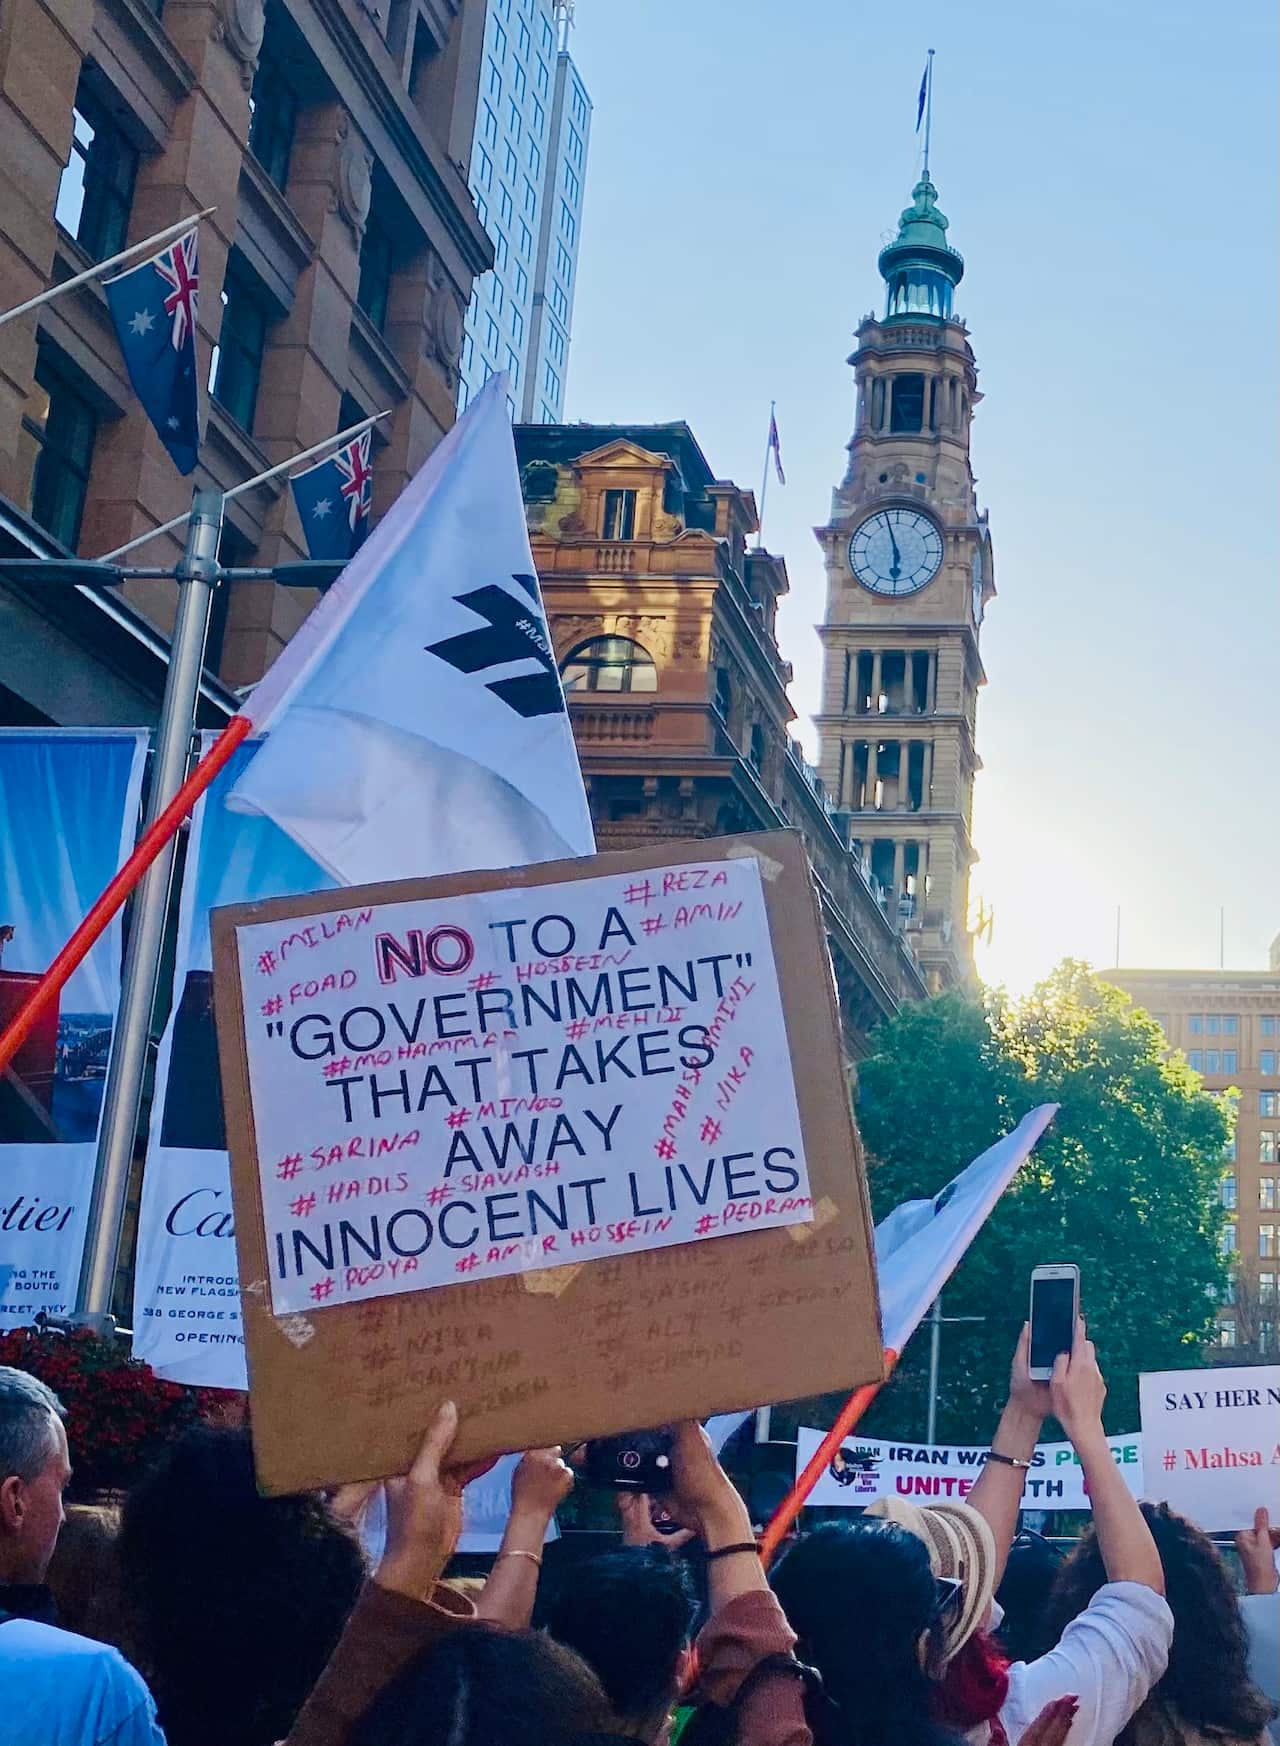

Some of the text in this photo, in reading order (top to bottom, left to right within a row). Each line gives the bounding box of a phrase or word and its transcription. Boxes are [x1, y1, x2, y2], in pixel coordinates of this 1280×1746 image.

[257, 909, 372, 976] #MILAN
[374, 907, 637, 985] NO TO A
[266, 953, 752, 1060] "GOVERNMENT"
[326, 1024, 716, 1123] THAT TAKES
[443, 1104, 624, 1177] AWAY
[276, 1177, 606, 1279] INNOCENT
[629, 1147, 800, 1217] LIVES
[32, 1270, 57, 1279] THE
[157, 1285, 186, 1295] NEW
[168, 1309, 225, 1320] GEORGE
[1164, 1391, 1208, 1411] SAY
[1215, 1388, 1262, 1409] HER
[889, 1447, 949, 1466] IRAN
[1184, 1446, 1263, 1471] Mahsa
